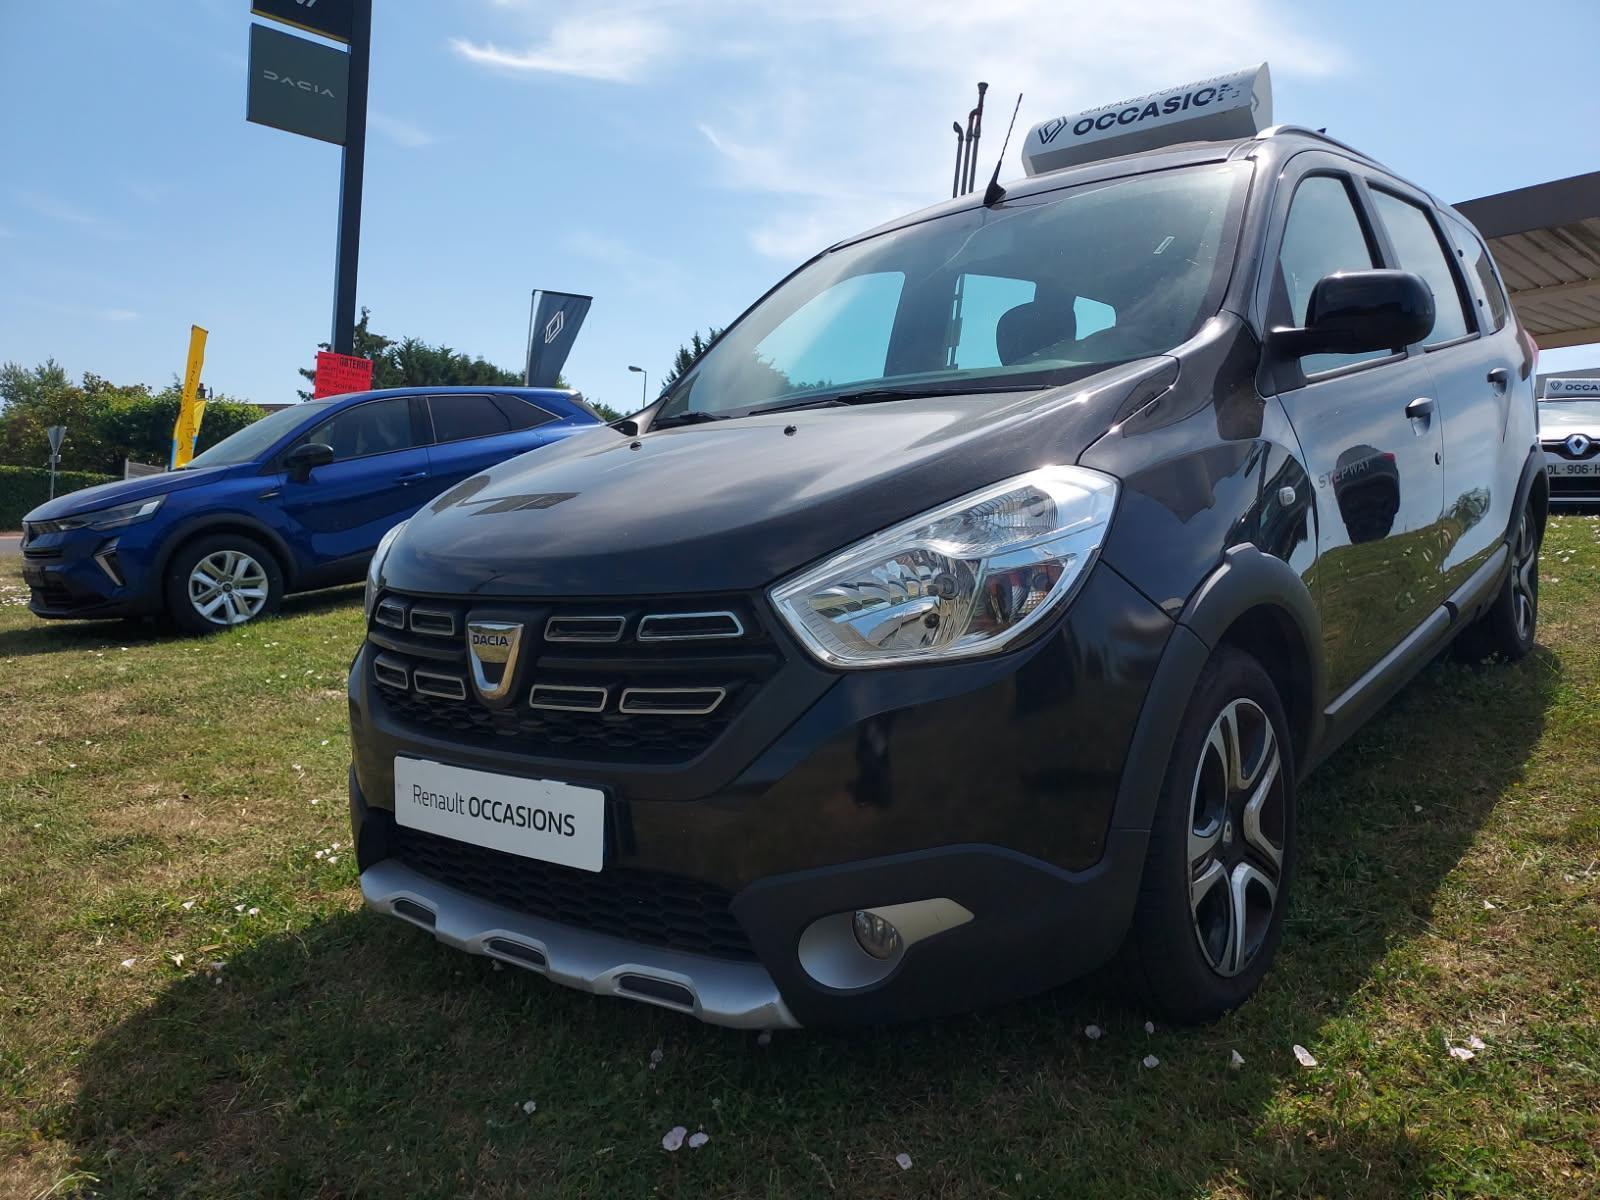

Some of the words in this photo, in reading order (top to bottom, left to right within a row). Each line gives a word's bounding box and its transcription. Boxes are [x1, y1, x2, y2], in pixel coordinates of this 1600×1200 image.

[263, 69, 335, 98] DACIA
[1317, 459, 1370, 489] STEPWAY
[472, 634, 509, 647] DACIA
[412, 783, 465, 815] Renault
[468, 796, 576, 837] OCCASIONS
